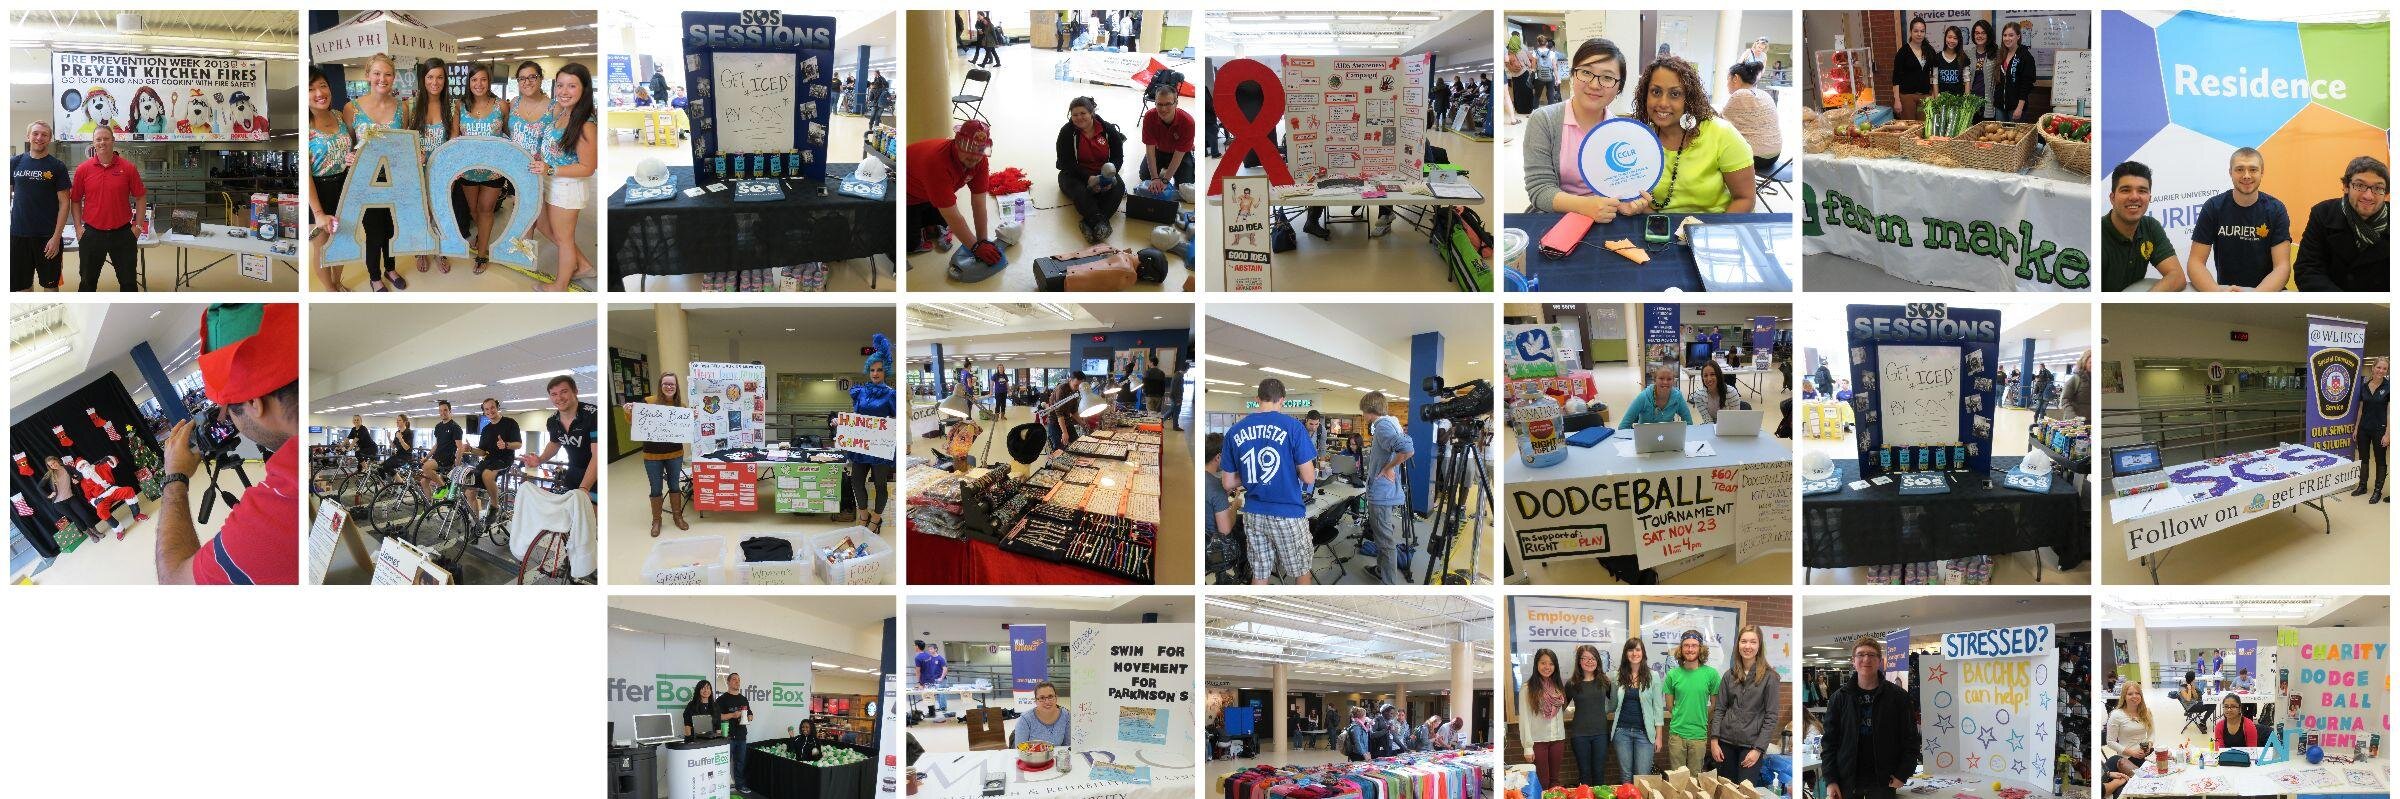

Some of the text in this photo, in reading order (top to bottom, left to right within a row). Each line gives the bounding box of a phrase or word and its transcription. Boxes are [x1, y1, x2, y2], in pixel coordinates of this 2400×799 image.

[742, 10, 780, 25] SOS
[315, 33, 381, 54] ALPHA PHI
[392, 33, 434, 50] ALPHA
[689, 24, 830, 49] SESSIONS
[61, 54, 230, 69] FIRE PREVENTION WEEK 2013
[61, 63, 257, 81] PREVENT KITCHEN FIRES
[214, 80, 229, 88] FIRE
[721, 69, 788, 92] GET ICED
[2174, 63, 2347, 100] Residence
[467, 122, 491, 132] ALPHA
[2182, 189, 2220, 200] UNIVERSITY
[1822, 189, 1913, 247] farm
[1229, 223, 1263, 232] BAD IDEA
[1229, 251, 1268, 262] GOOD IDEA
[1234, 264, 1263, 272] ABSTAIN
[1907, 303, 1945, 318] SOS
[1854, 317, 1995, 342] SESSIONS
[1885, 361, 1953, 385] GET ICED
[911, 407, 937, 421] or.ca
[2325, 403, 2344, 411] Service
[838, 413, 888, 431] HUNGER
[1233, 424, 1288, 447] BAUTISTA
[2311, 423, 2355, 438] OUR SERVICE
[558, 433, 583, 448] sky
[1531, 438, 1557, 449] RIGHT
[2322, 438, 2352, 451] STUDENT
[1240, 445, 1281, 484] 19
[1513, 475, 1713, 519] DODGEBALL
[1637, 502, 1735, 530] TOURNAMENT
[2128, 514, 2209, 551] Follow
[2215, 505, 2238, 522] on
[2271, 488, 2294, 509] get
[2298, 473, 2332, 497] FREE
[1697, 517, 1717, 533] 23
[1525, 542, 1559, 553] RIGHT
[1579, 536, 1602, 547] PLAY
[1528, 610, 1594, 624] Employee
[1528, 626, 1611, 639] Service Desk
[1652, 629, 1681, 640] Servi
[1947, 625, 2049, 657] STRESSED?
[1110, 645, 1185, 657] SWIM FOR
[2301, 643, 2388, 660] CHARITY
[1113, 662, 1188, 674] MOVEMENT
[1963, 660, 2031, 688] BACCHUS
[1131, 677, 1157, 688] FOR
[2301, 668, 2369, 687] DODGE
[747, 684, 804, 703] ufferBox
[1965, 688, 1991, 704] can
[2322, 692, 2371, 708] BALL
[2296, 715, 2364, 731] TOURNA
